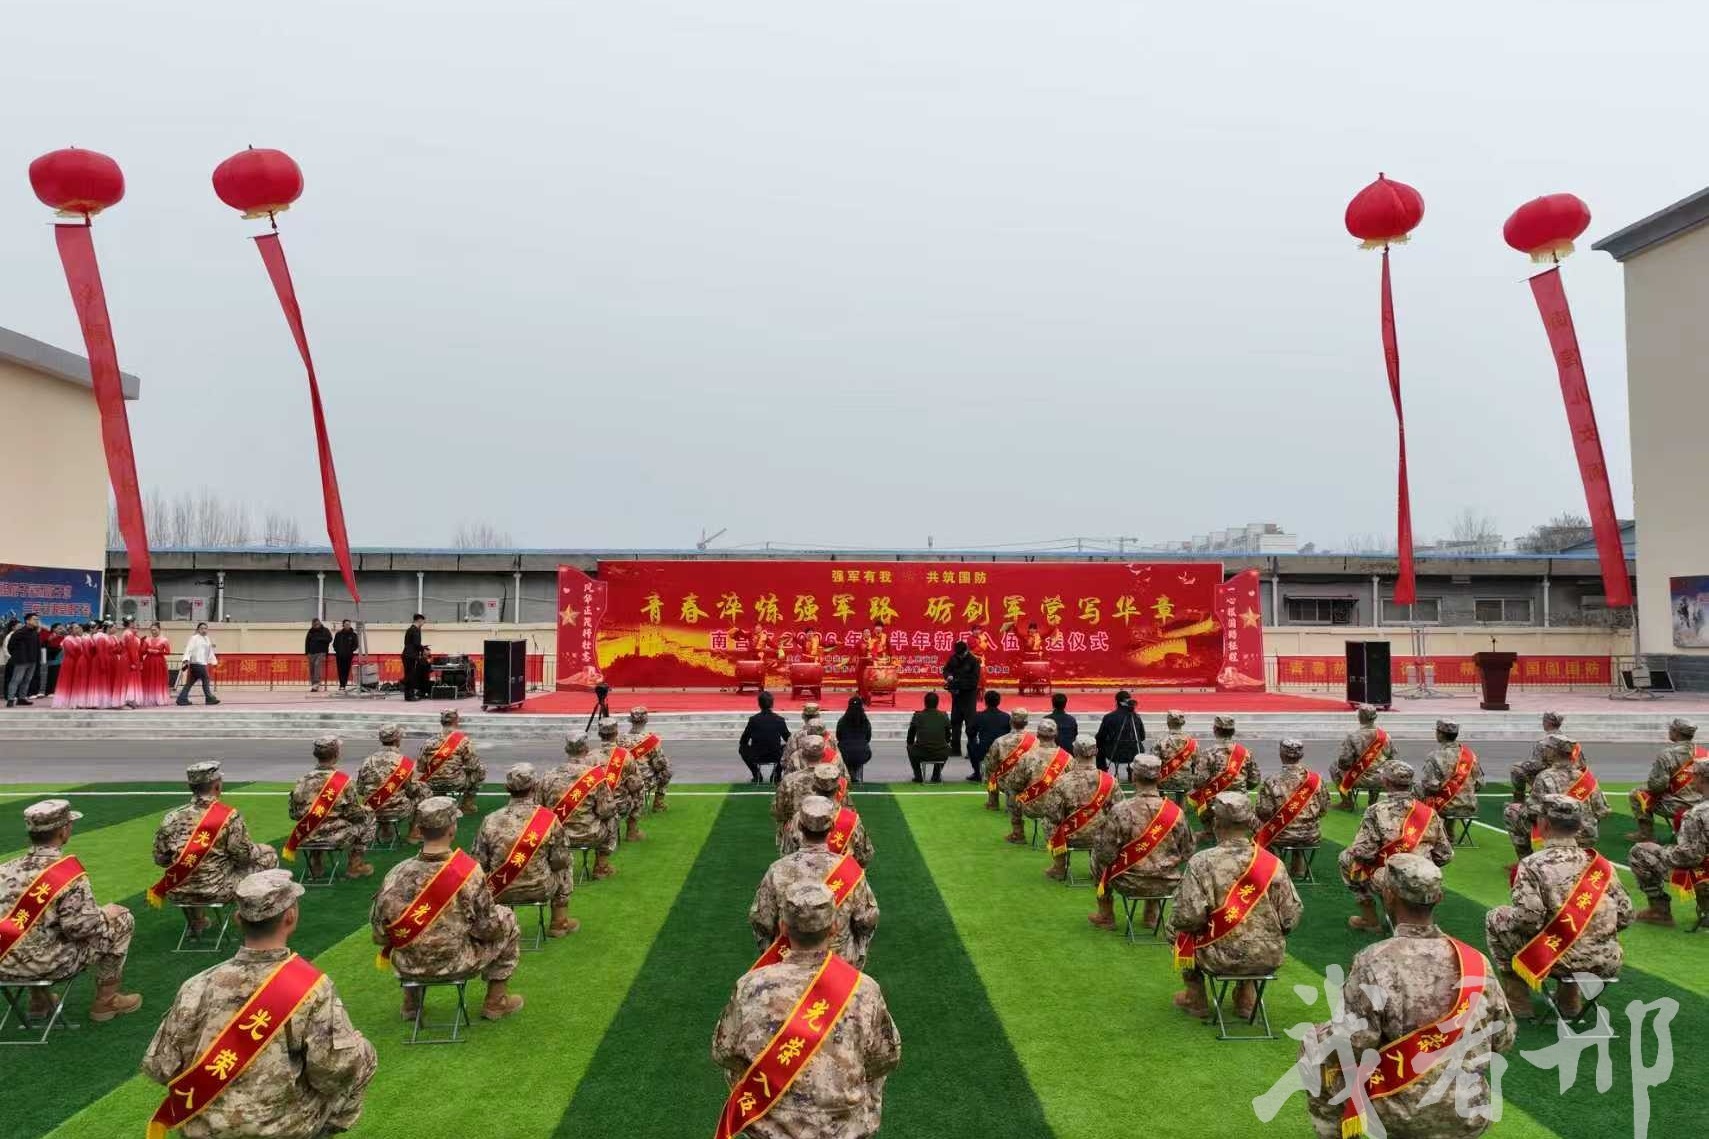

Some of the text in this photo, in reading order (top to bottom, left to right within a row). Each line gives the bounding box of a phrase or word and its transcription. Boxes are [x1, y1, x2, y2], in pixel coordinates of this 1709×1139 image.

[641, 592, 899, 625] 青春淬炼强军路
[832, 570, 988, 585] 强军有我 共筑国防
[1544, 869, 1605, 952] 光荣入伍
[174, 1008, 272, 1110] 光荣入
[736, 998, 830, 1116] 光荣入伍
